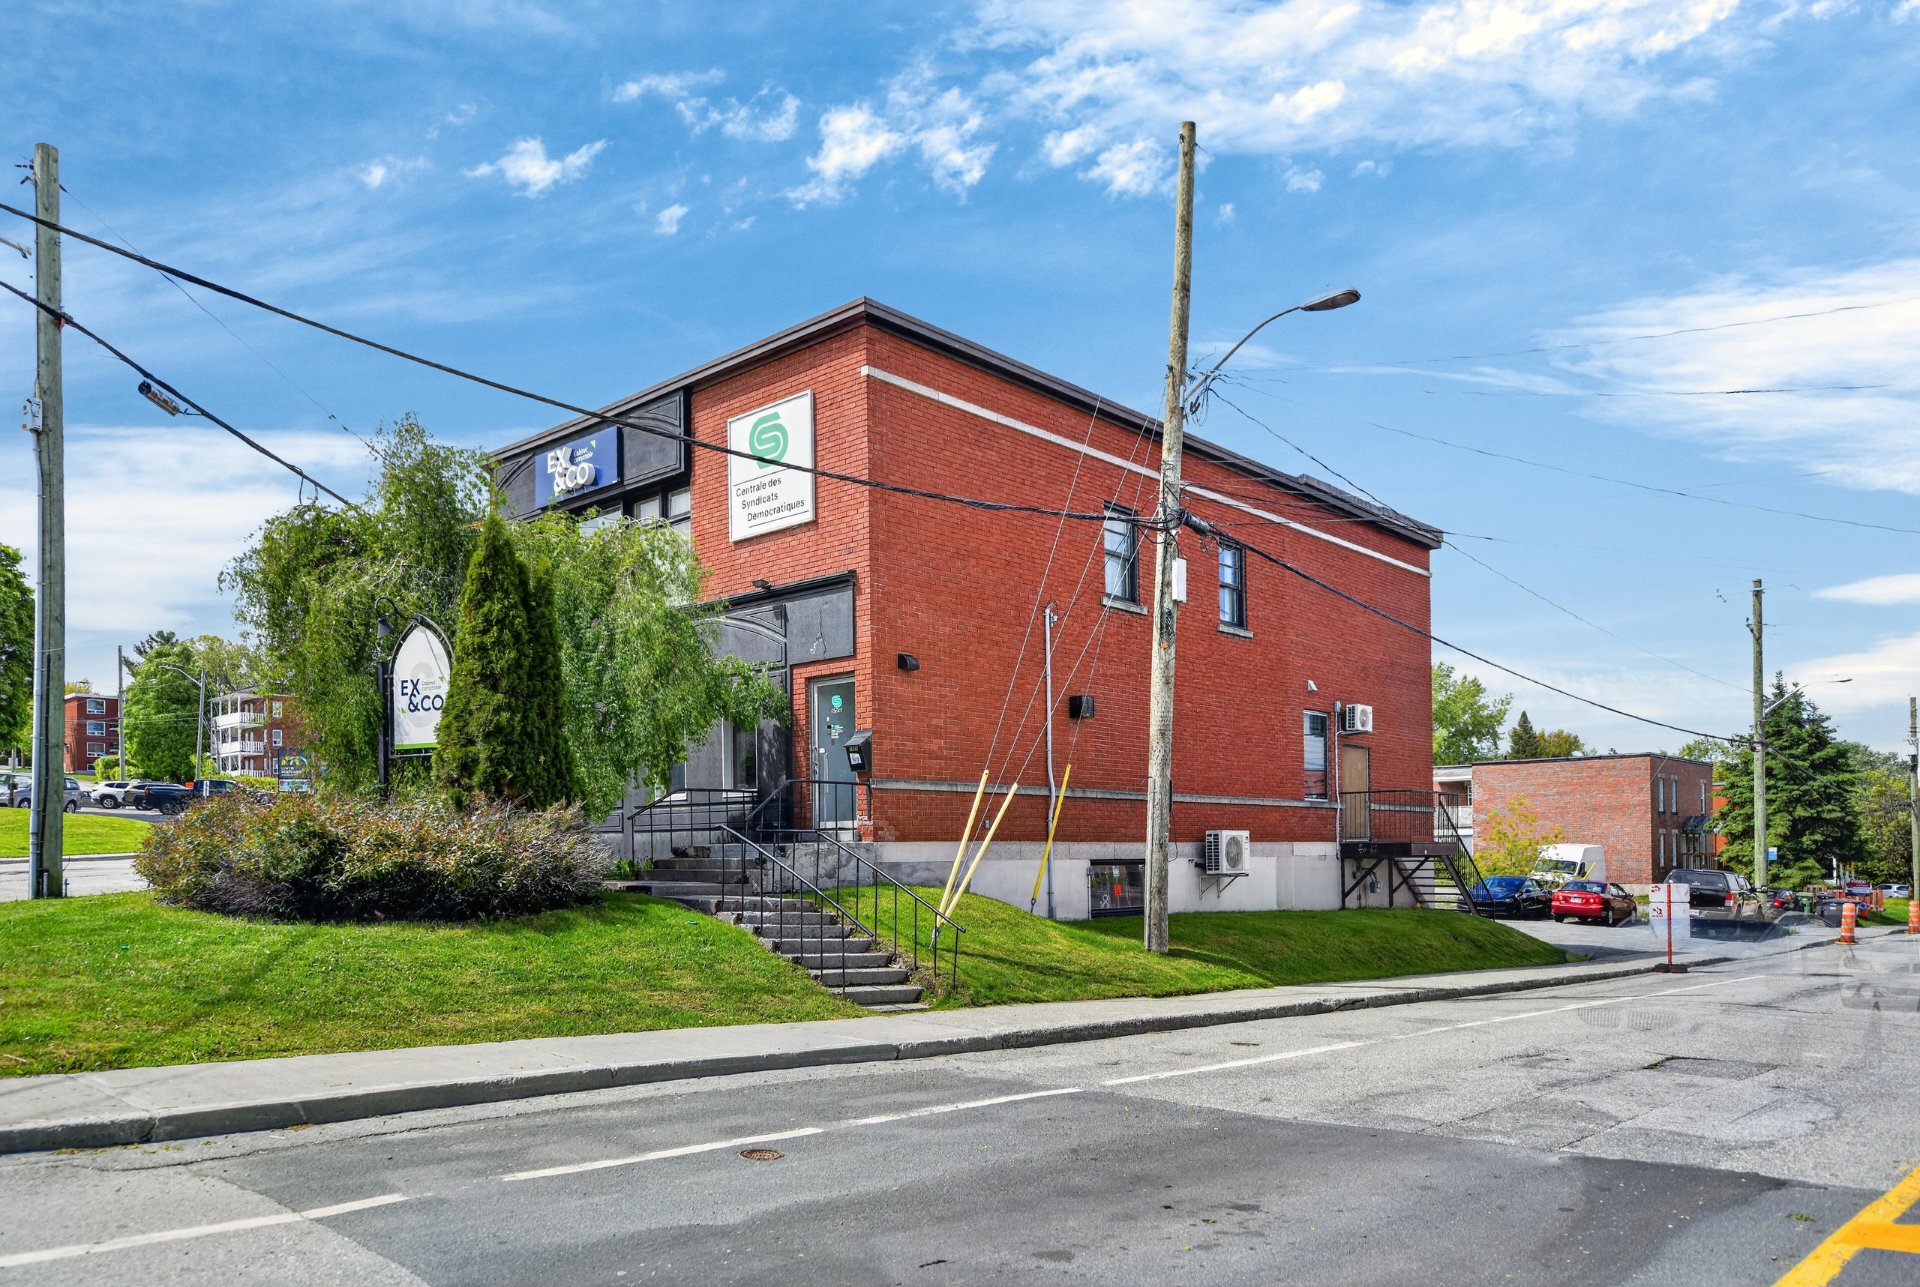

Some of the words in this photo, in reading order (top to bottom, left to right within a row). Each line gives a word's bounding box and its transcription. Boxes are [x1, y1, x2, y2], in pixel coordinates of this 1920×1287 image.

[547, 447, 572, 474] EX
[554, 462, 595, 493] &CO
[736, 481, 767, 497] Centrale
[768, 477, 782, 488] des
[741, 492, 779, 510] Syndicats
[401, 678, 420, 696] EX
[408, 693, 444, 712] &CO
